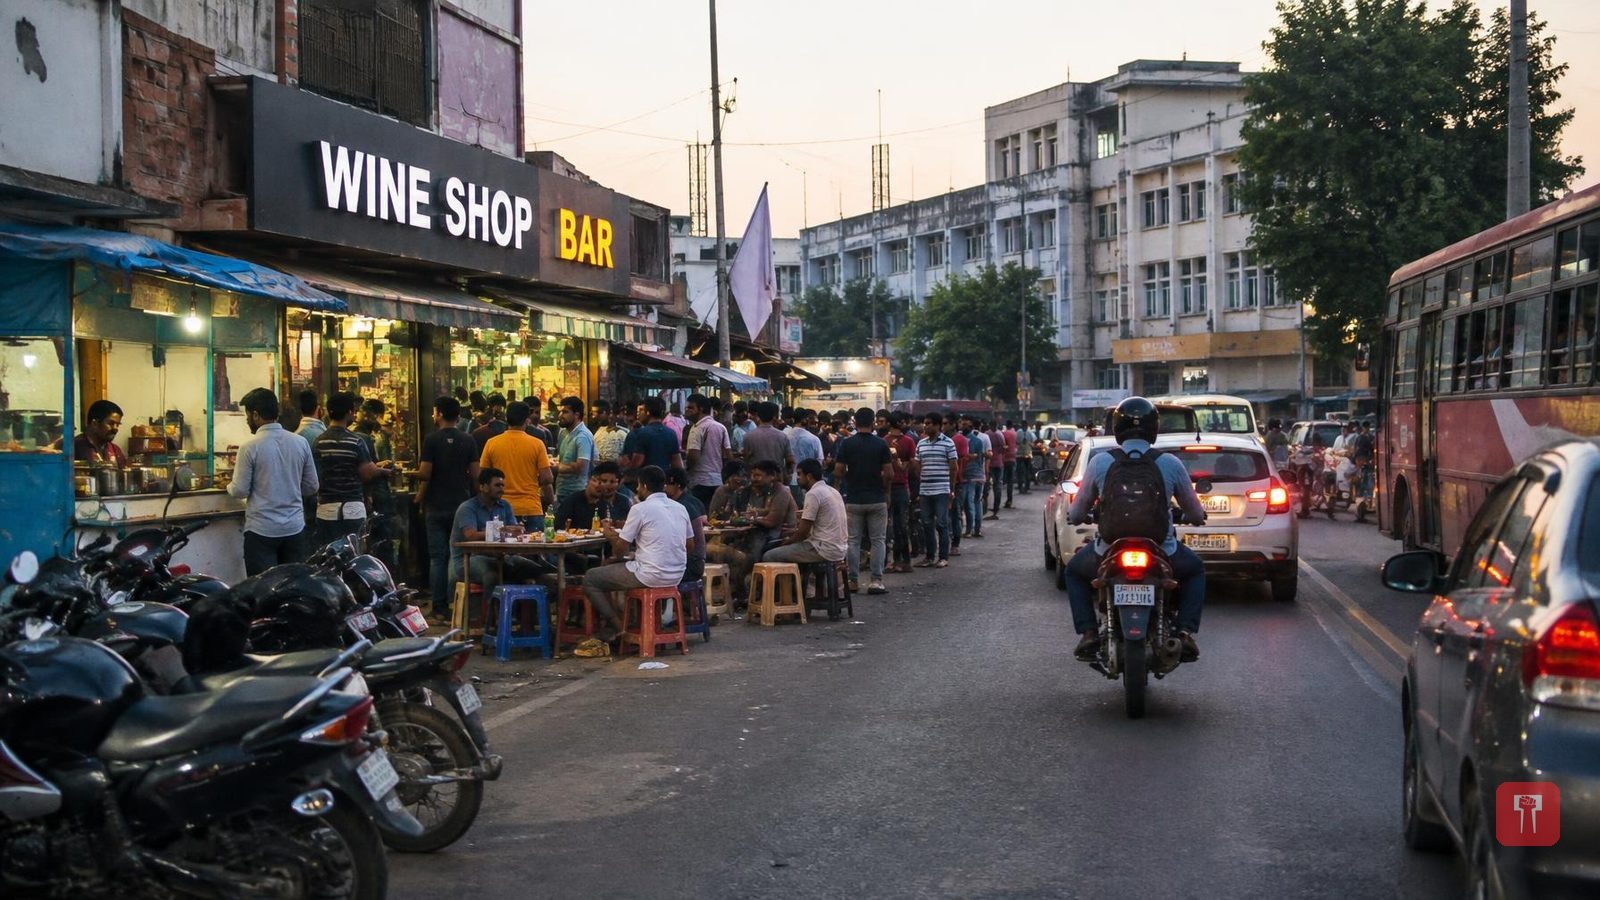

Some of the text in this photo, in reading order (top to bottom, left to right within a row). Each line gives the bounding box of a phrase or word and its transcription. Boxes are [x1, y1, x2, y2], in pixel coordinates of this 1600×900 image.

[320, 140, 533, 250] WINE SHOP
[558, 207, 614, 269] BAR
